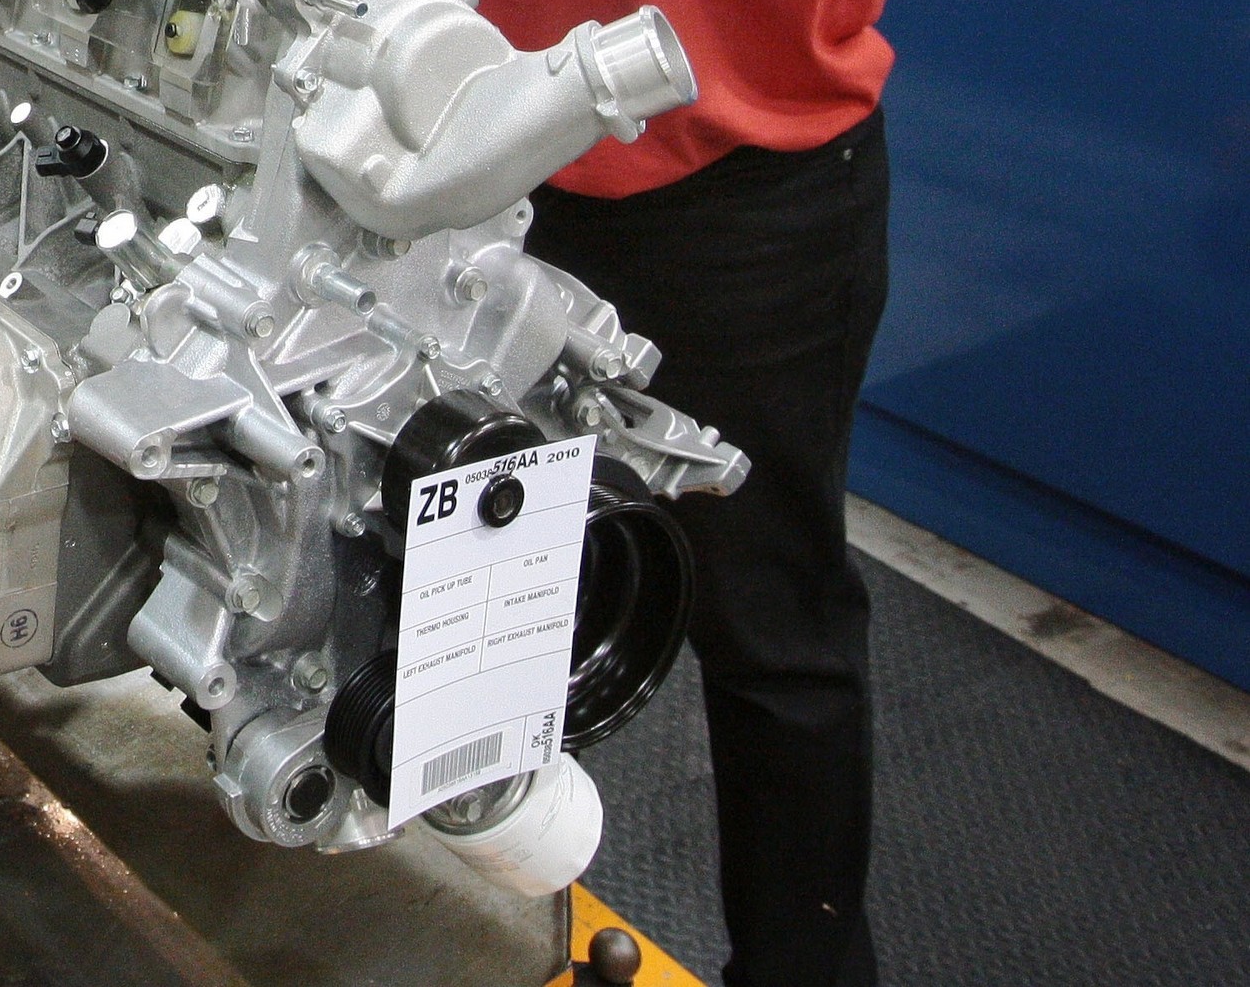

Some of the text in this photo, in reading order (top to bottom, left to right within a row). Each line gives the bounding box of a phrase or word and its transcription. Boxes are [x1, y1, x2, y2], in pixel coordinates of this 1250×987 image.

[546, 447, 580, 464] 2010
[416, 478, 459, 526] ZB
[523, 554, 549, 568] OIL PAN
[419, 575, 473, 600] OIL PICK UP TUBE
[503, 586, 560, 608] INTAKE MANIFOLD
[416, 612, 469, 638] THERMO HOUSING
[487, 619, 569, 648] RIGHT EXHAUST MANIFOLD
[403, 645, 477, 680] LEFT EXHAUST MANIFOLD
[531, 733, 541, 748] OK
